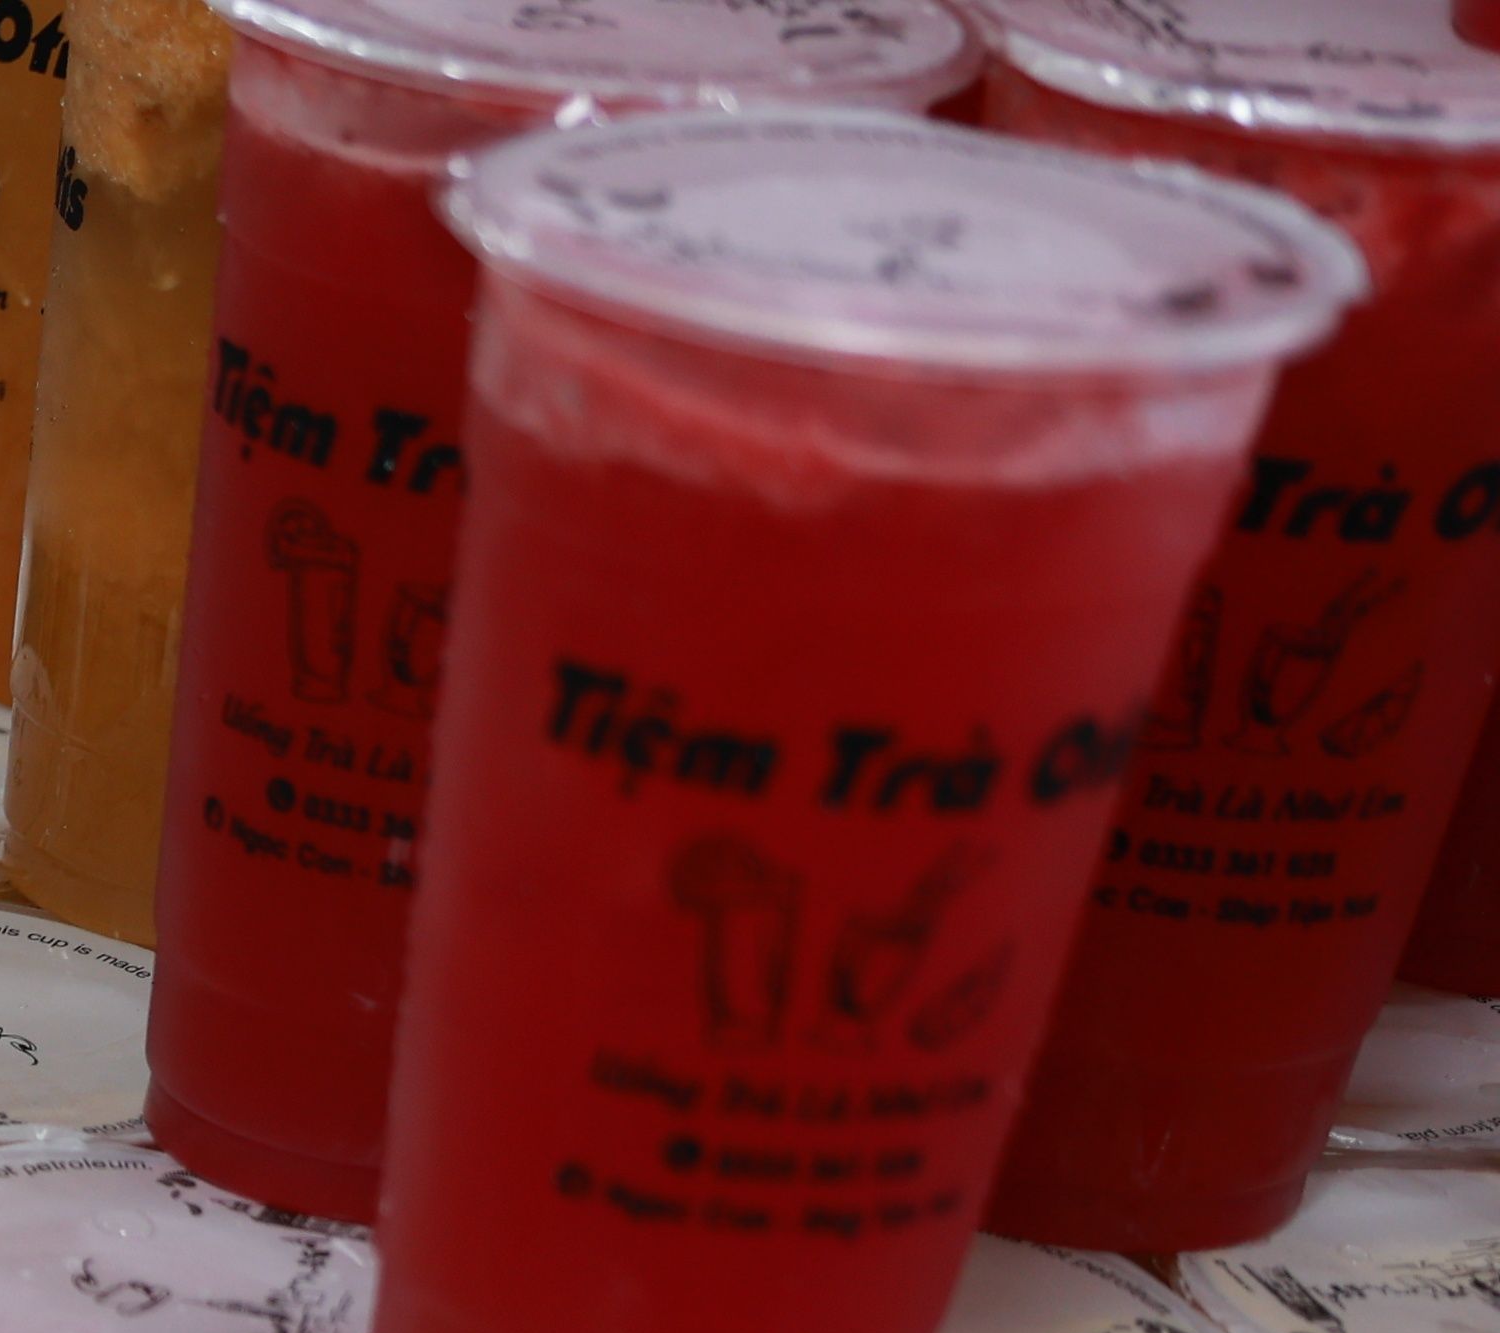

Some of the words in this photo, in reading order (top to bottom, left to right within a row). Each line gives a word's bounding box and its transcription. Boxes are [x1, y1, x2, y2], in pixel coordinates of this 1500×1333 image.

[213, 336, 337, 468] Tiệm
[367, 407, 467, 494] Tr
[546, 657, 781, 796] Tiệm
[27, 931, 69, 948] cup
[73, 943, 93, 956] is
[96, 952, 152, 980] made
[23, 1156, 154, 1176] petroleum.
